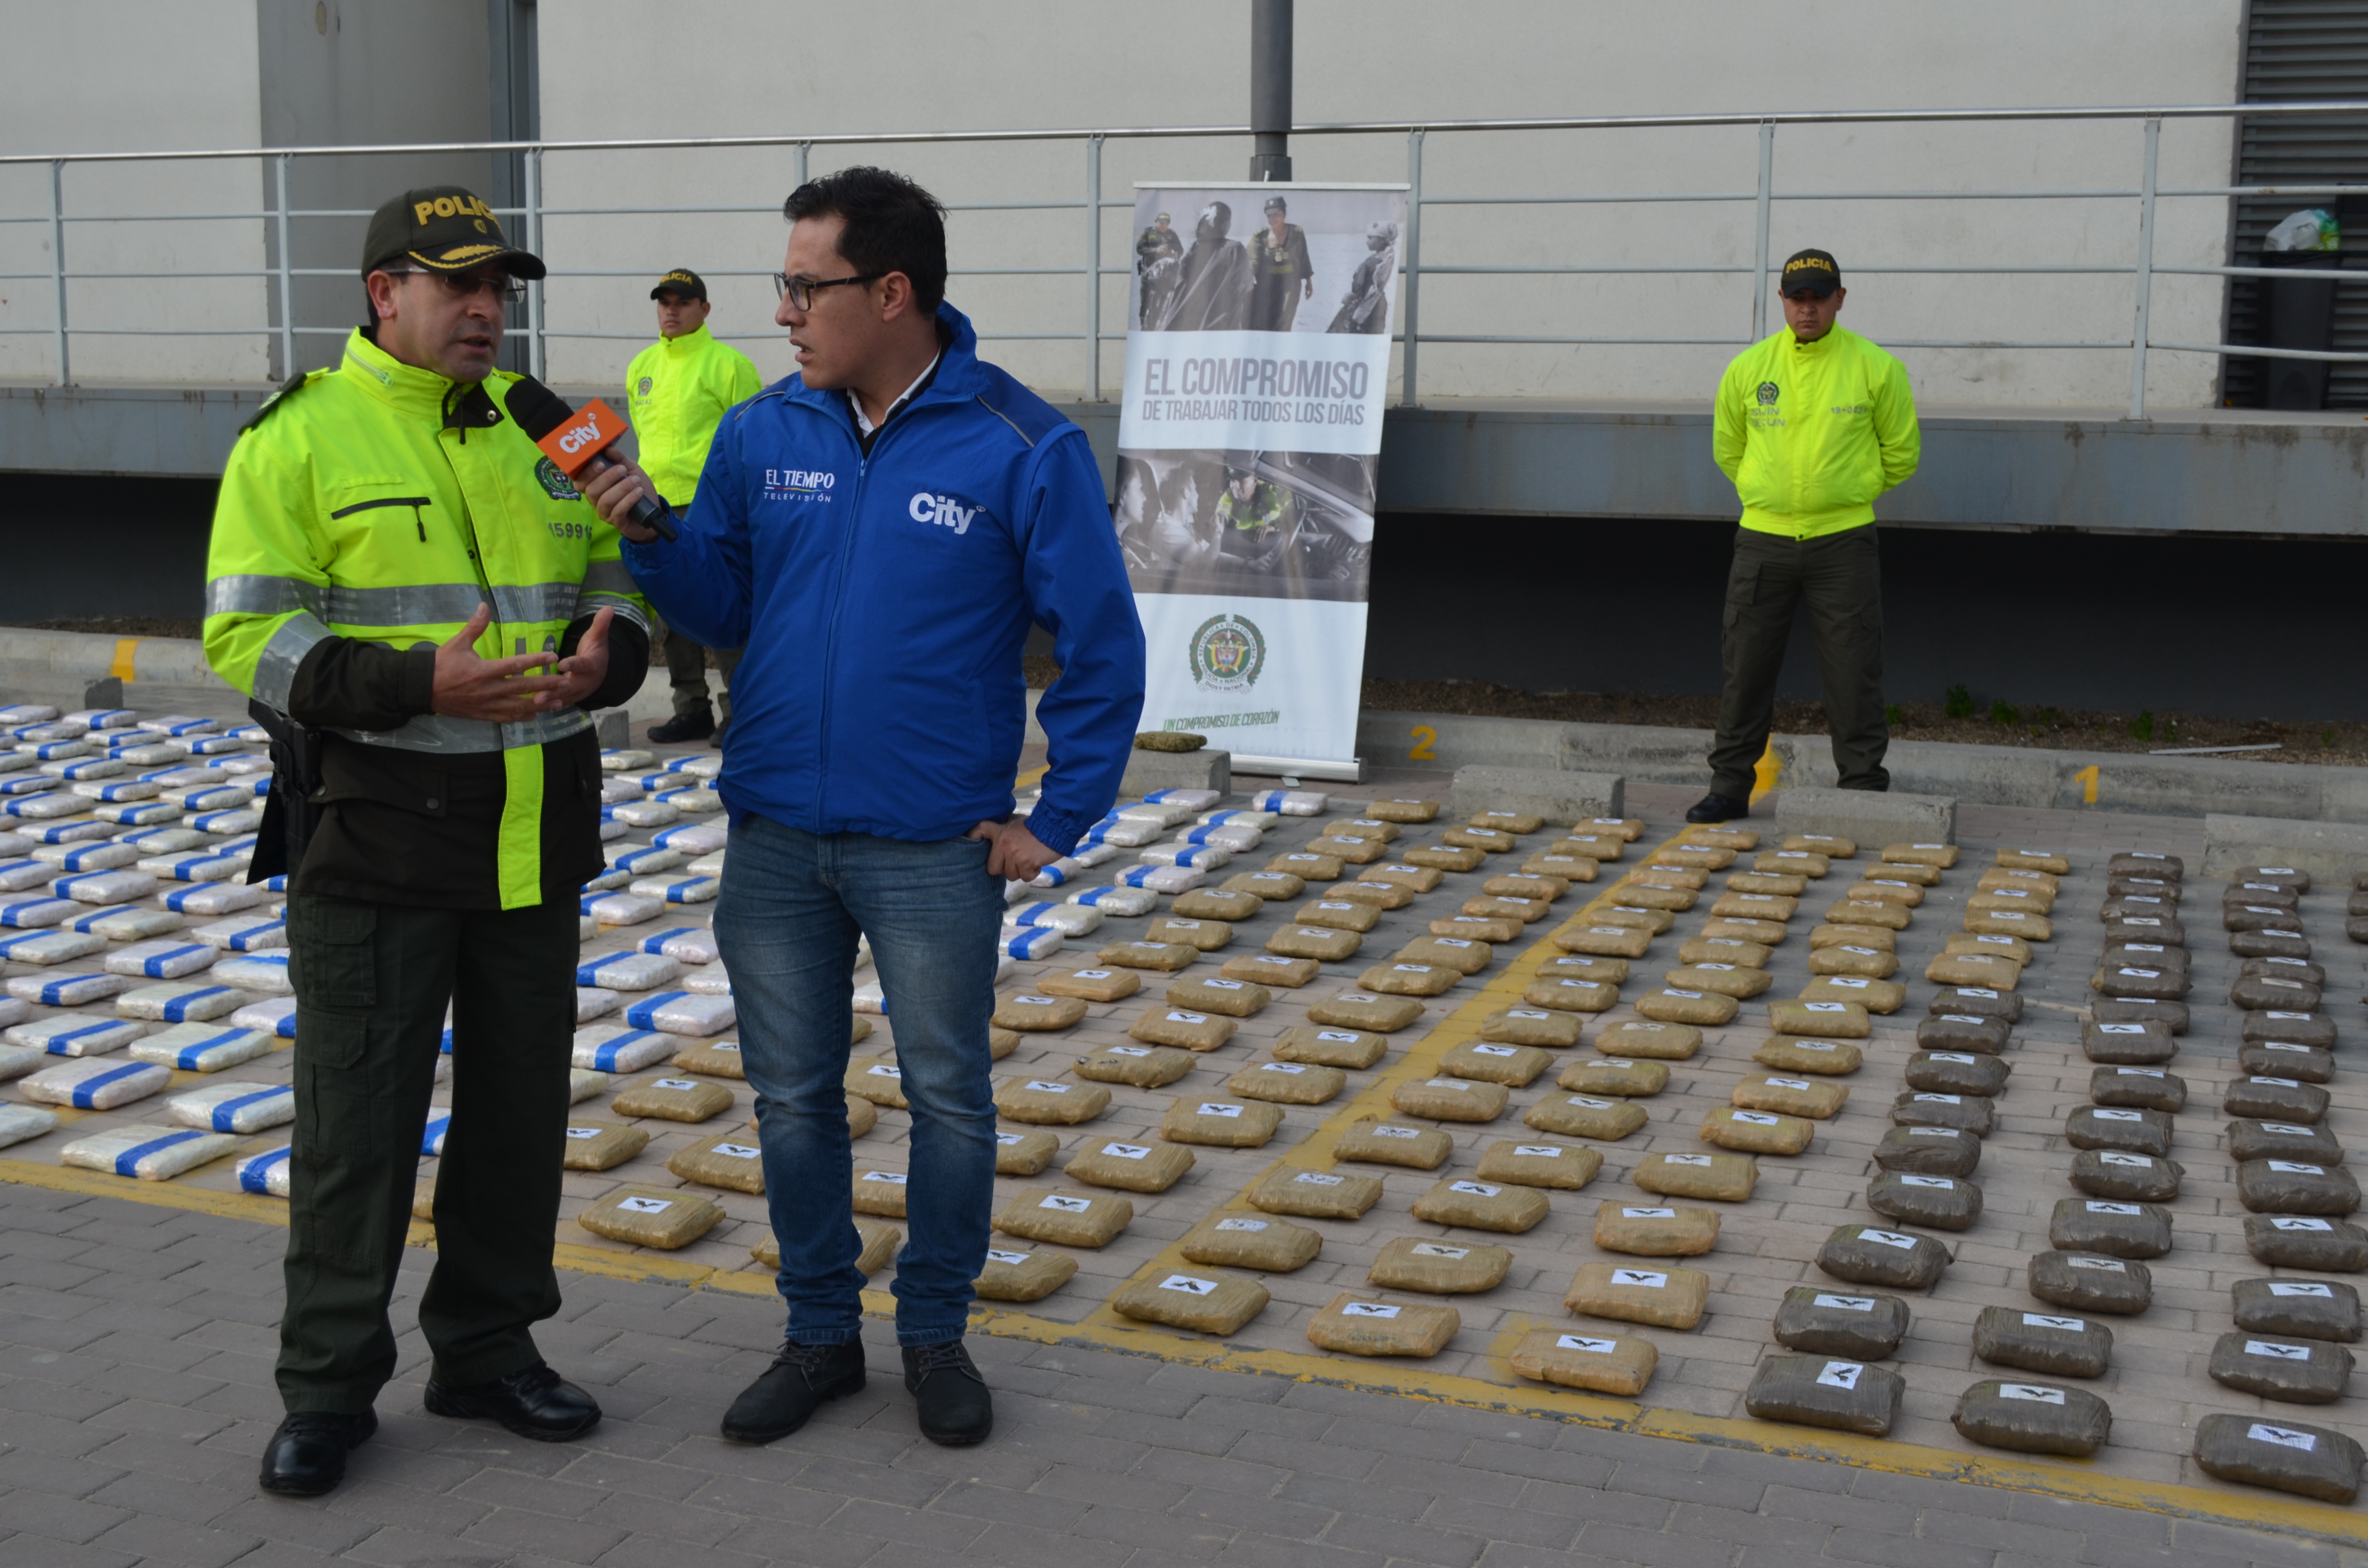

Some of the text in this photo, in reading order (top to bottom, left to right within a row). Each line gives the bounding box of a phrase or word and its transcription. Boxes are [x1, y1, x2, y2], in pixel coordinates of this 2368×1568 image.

[414, 196, 502, 233] POLIC
[1786, 257, 1832, 274] POLICIA
[1145, 358, 1369, 400] EL COMPROMISO
[1143, 400, 1365, 425] DE TRABAJAR TODOS LOS DÍAS
[559, 421, 601, 453] City
[766, 469, 835, 489] EL TIEMPO
[763, 492, 831, 502] TELEVISIÓN
[909, 492, 976, 535] City
[1198, 625, 1221, 657] REPUBLICA
[1240, 626, 1257, 659] COLOMBIA
[1200, 664, 1252, 684] POLICIA NACIONAL
[1205, 681, 1218, 690] DIOS
[1163, 709, 1280, 732] UN COMPROMISO DE CORAZÓN
[1408, 725, 1437, 760] 2
[2075, 765, 2099, 803] 1
